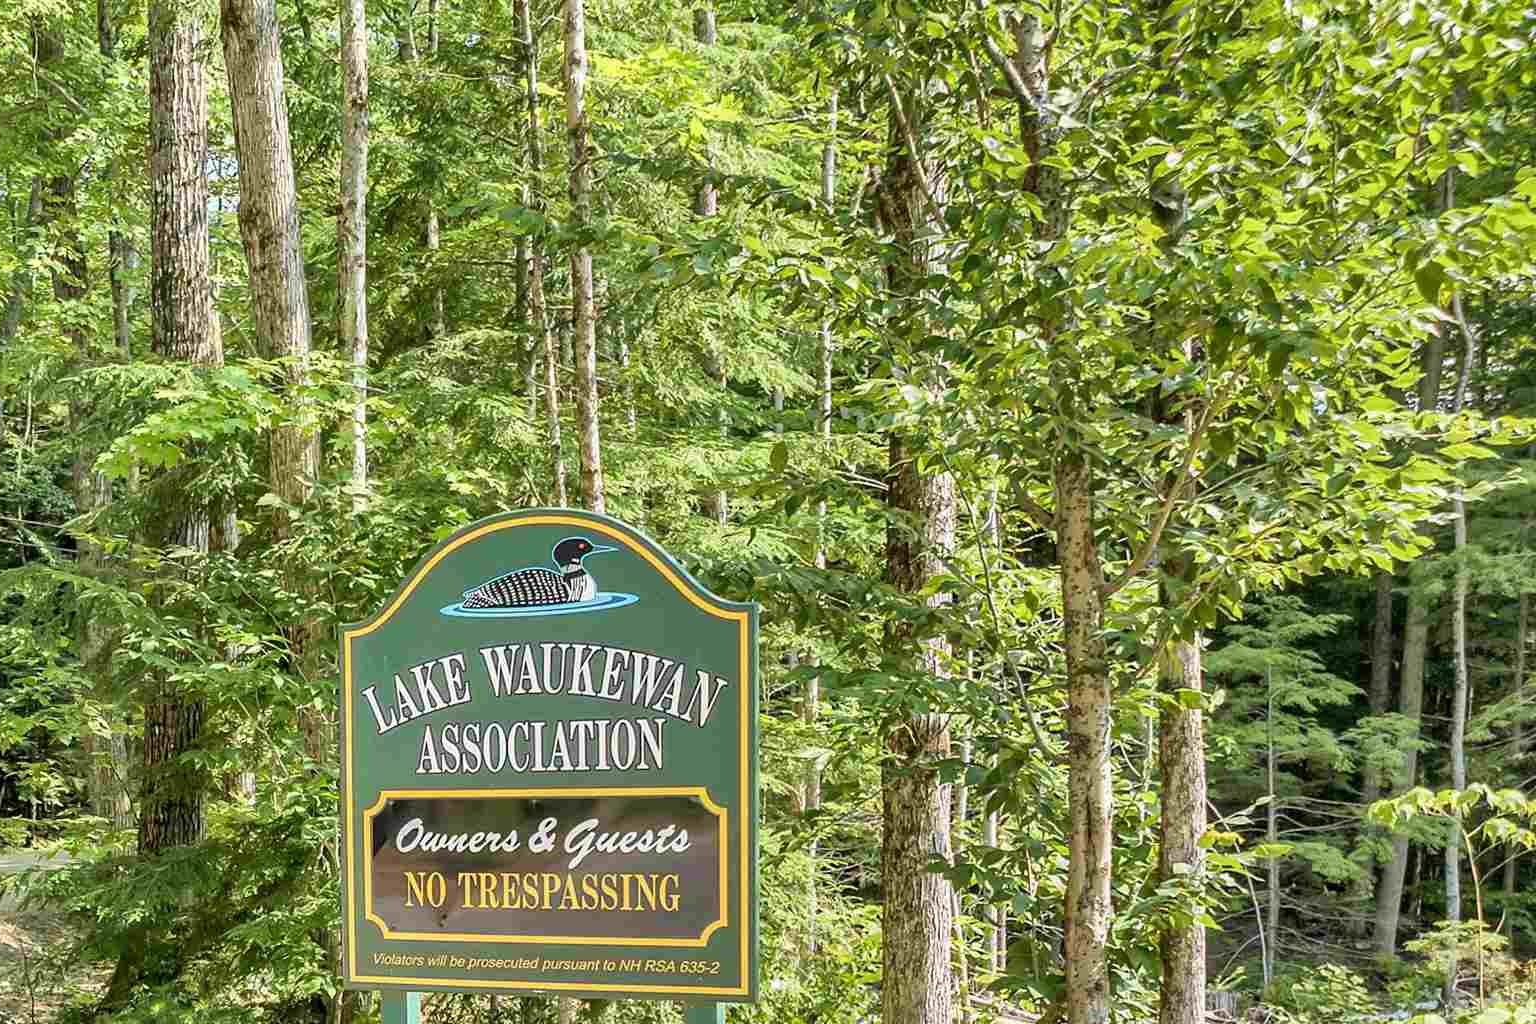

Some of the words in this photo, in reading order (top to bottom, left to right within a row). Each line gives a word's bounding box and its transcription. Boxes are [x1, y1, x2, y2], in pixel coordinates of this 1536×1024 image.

[361, 653, 472, 735] LAKE
[480, 642, 728, 728] WAUKEWAN
[415, 718, 667, 774] ASSOCIATION
[395, 817, 520, 853] Owners
[527, 817, 558, 853] &
[564, 818, 692, 870] Guests
[404, 871, 447, 908] NO
[458, 872, 682, 912] TRESPASSING
[373, 952, 424, 968] Violators
[427, 955, 448, 968] will
[450, 955, 465, 968] be
[465, 956, 539, 972] prosecuted
[542, 959, 601, 973] pursuant
[602, 959, 615, 972] to
[619, 959, 642, 972] NH
[644, 959, 676, 973] RSA
[680, 960, 721, 974] 635-2
